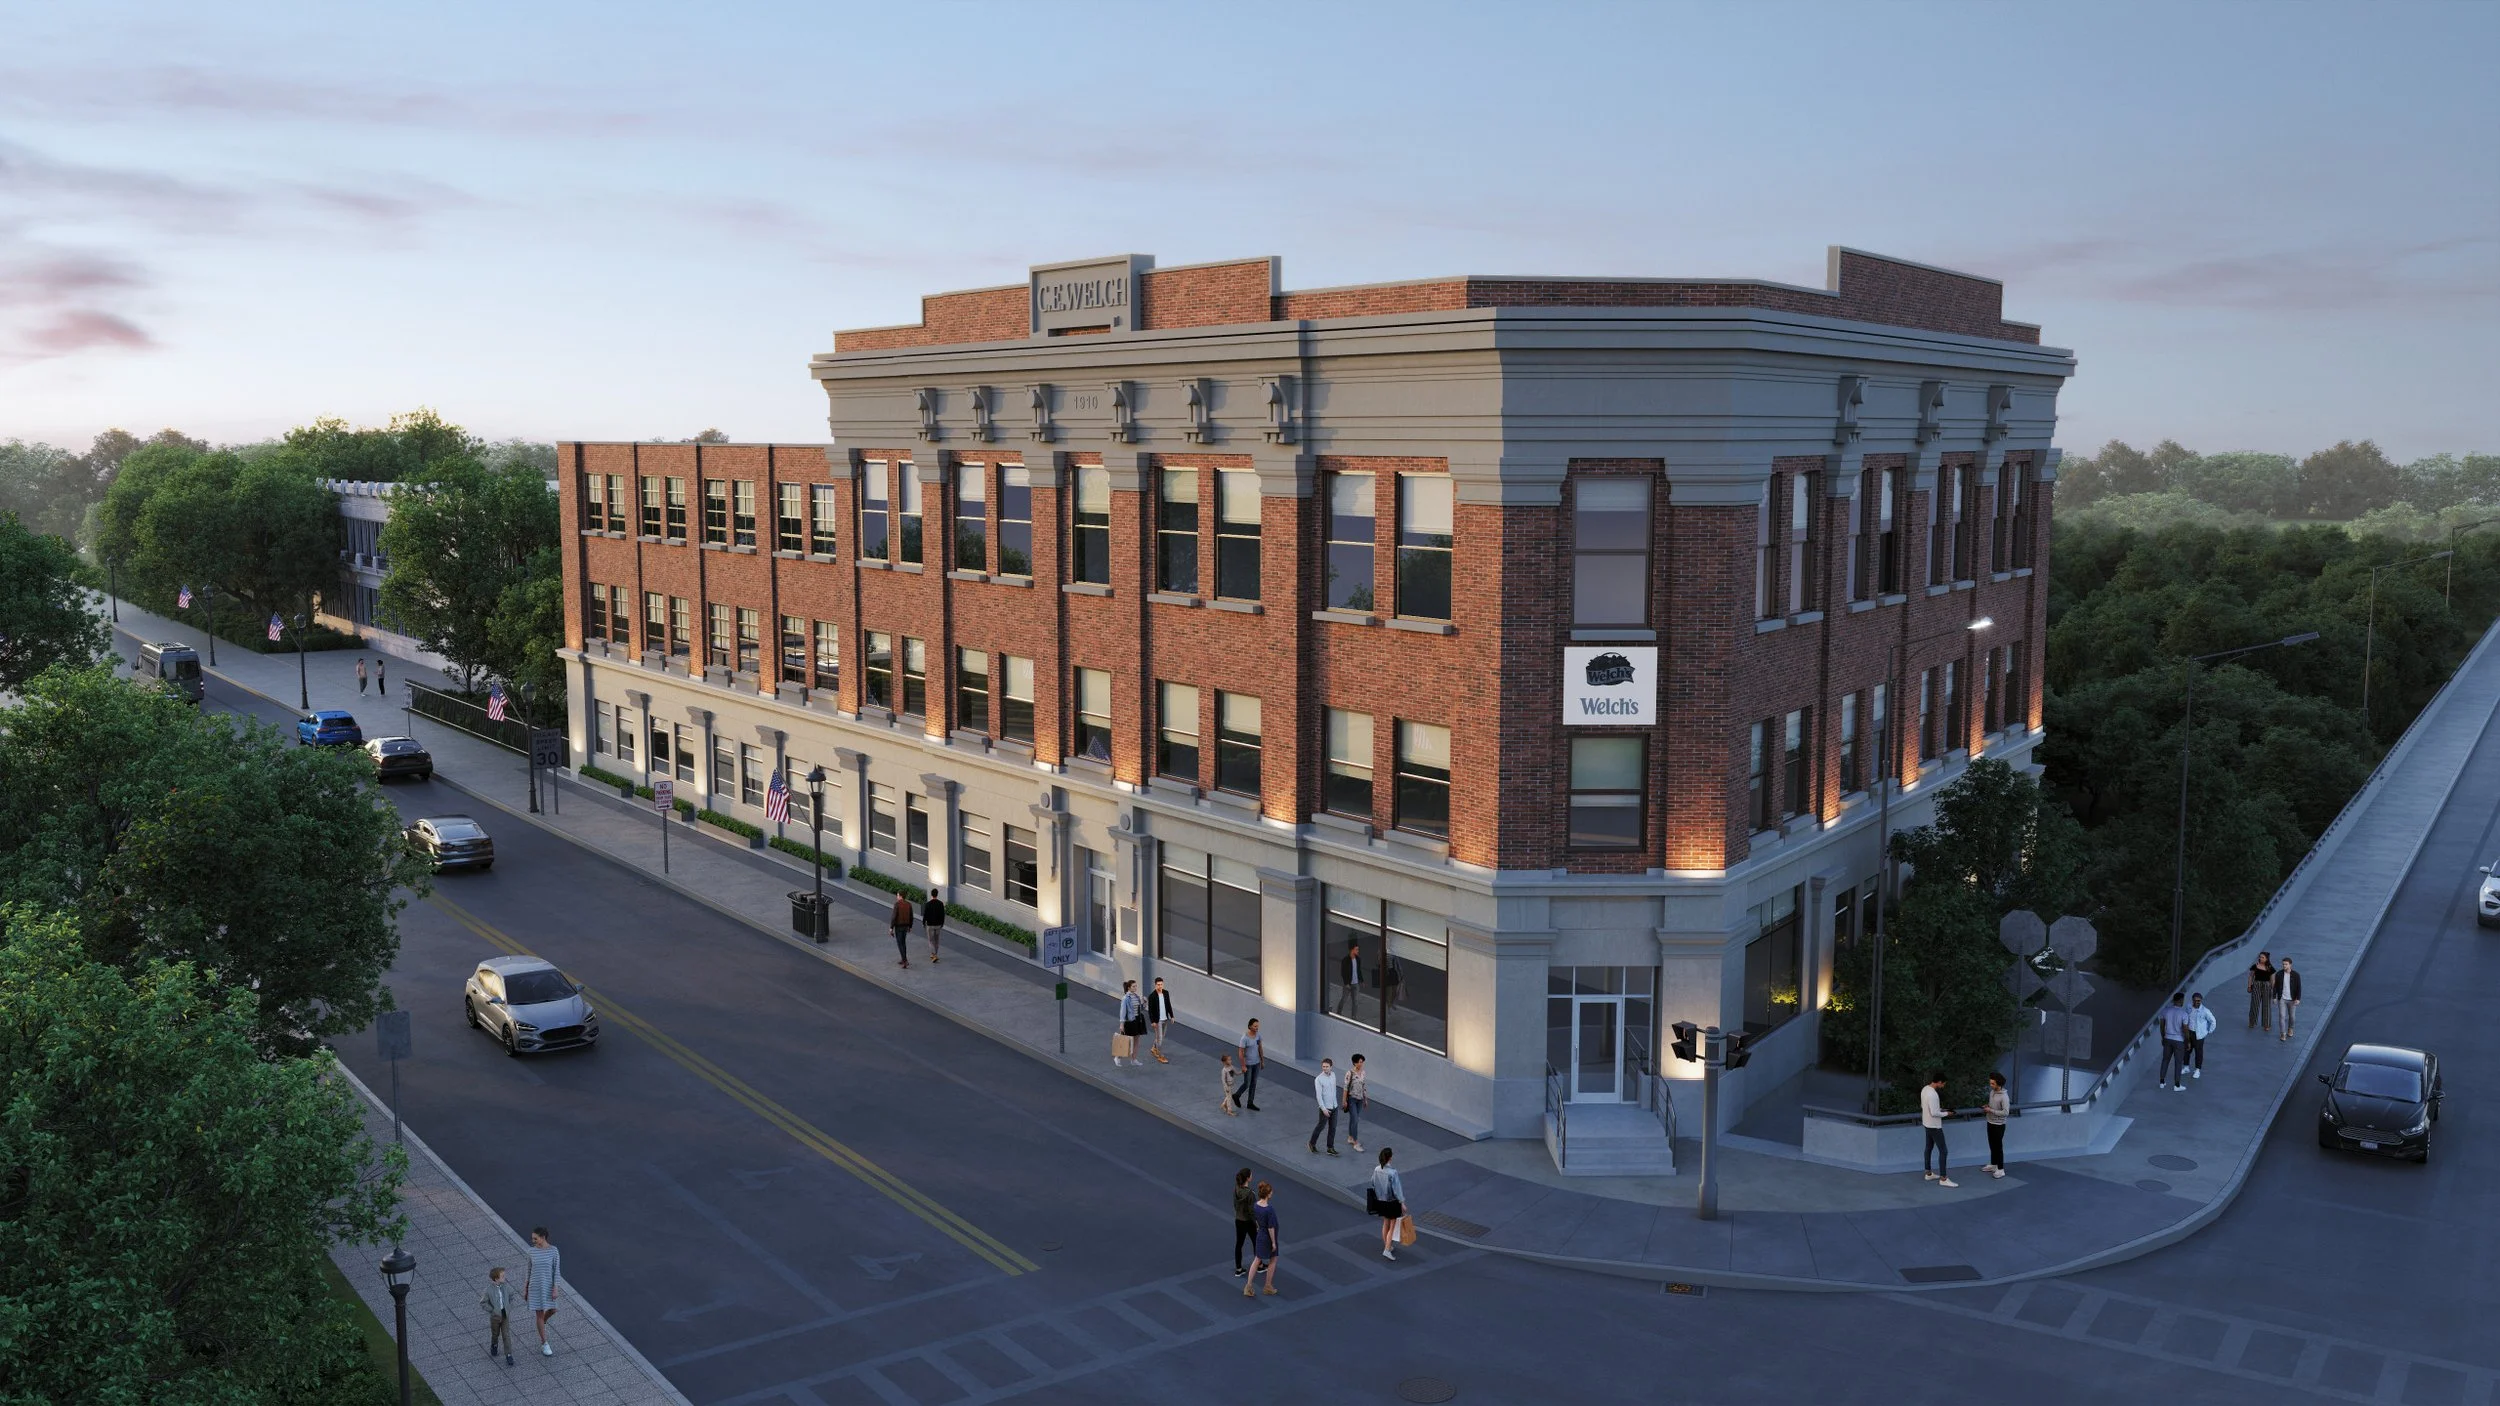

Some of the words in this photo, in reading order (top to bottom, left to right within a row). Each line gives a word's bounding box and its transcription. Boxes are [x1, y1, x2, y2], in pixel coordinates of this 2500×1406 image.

[1074, 396, 1098, 410] 1910
[1588, 667, 1632, 682] Welch's
[1580, 698, 1639, 716] Welch's
[536, 751, 558, 765] 30
[1052, 954, 1070, 964] ONLY
